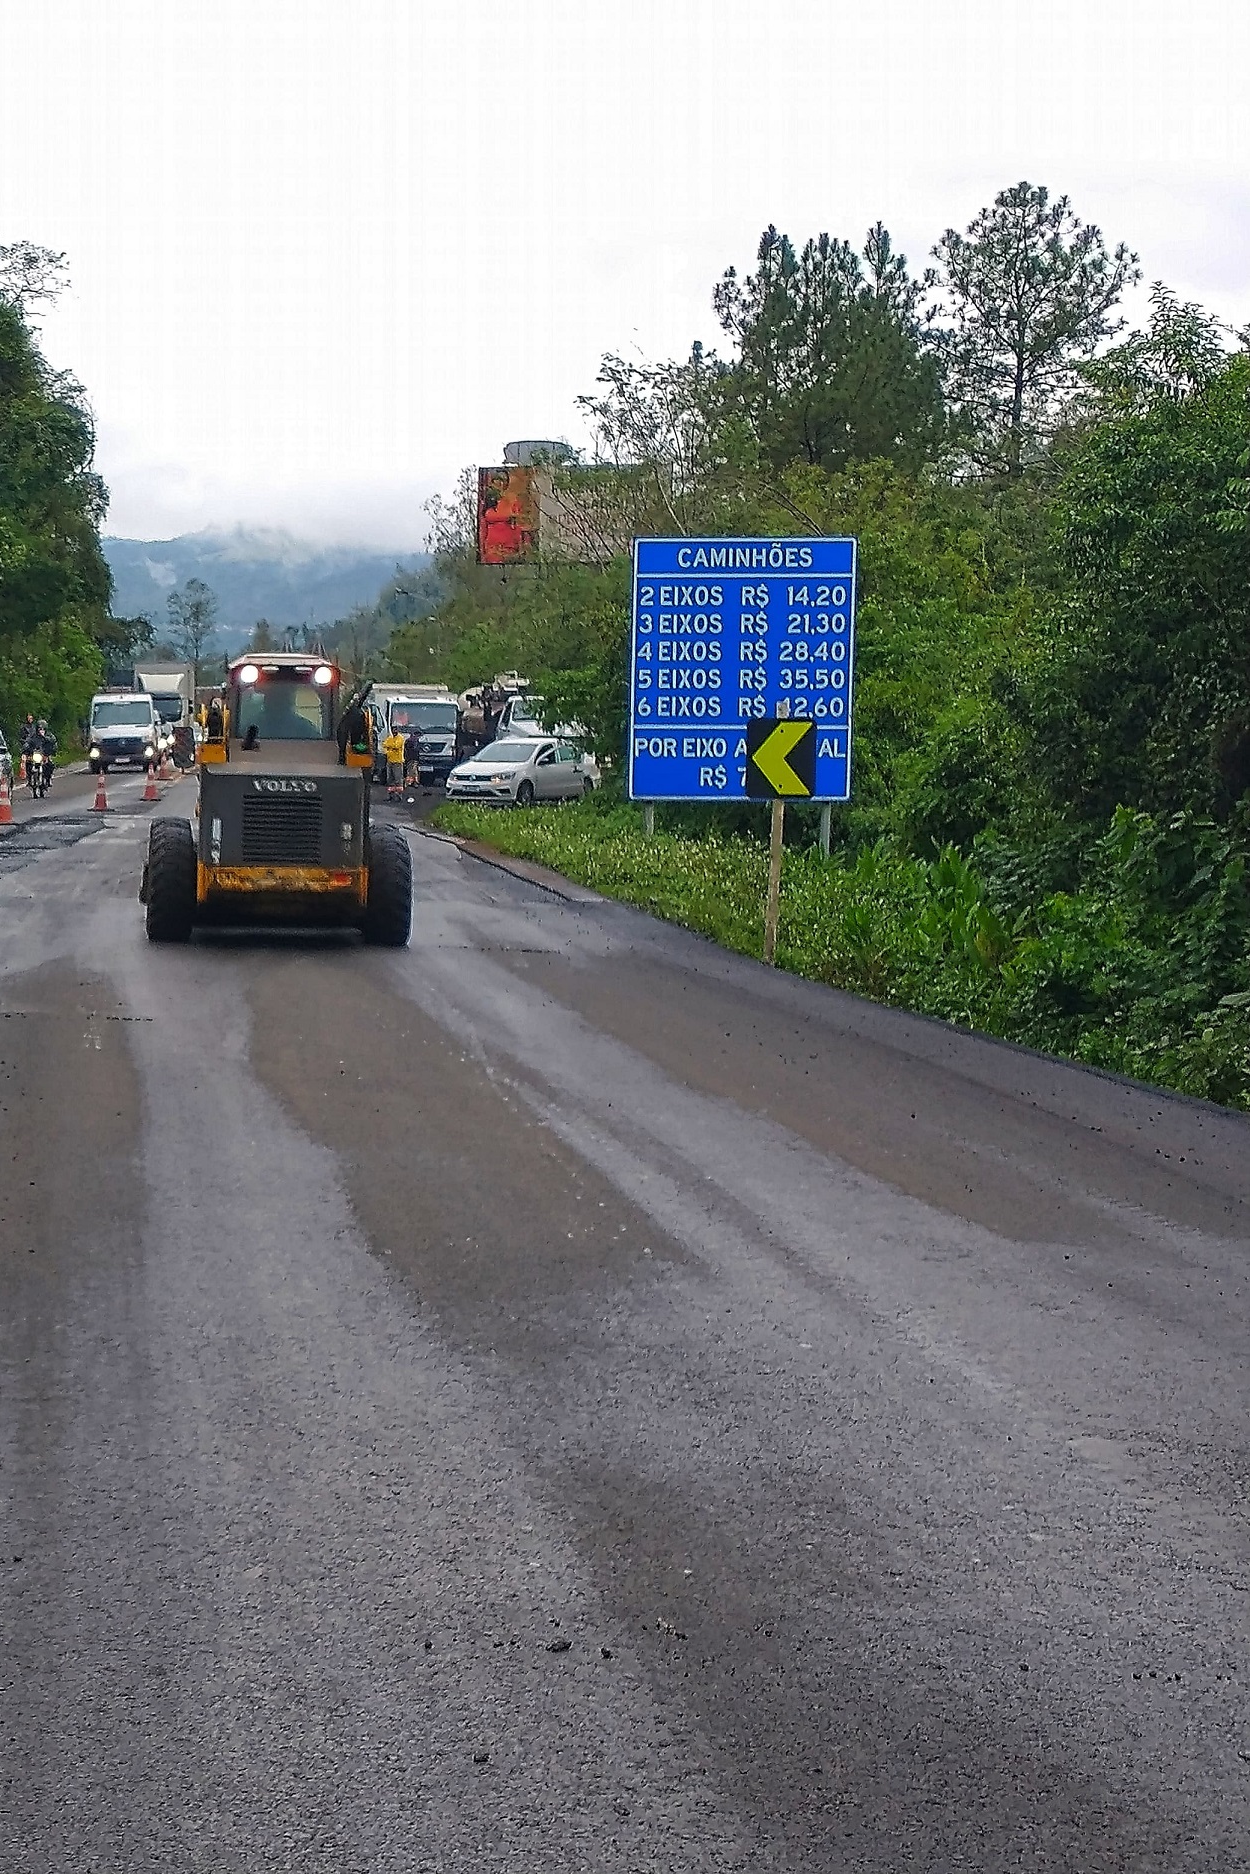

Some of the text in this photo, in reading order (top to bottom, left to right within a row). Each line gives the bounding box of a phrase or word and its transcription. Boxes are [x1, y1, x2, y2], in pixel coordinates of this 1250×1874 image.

[678, 543, 813, 568] CAMINHÕES
[641, 584, 846, 609] 2 EIXOS R$ 14,20
[640, 612, 845, 636] 3 EIXOS R$ 21,30
[638, 640, 845, 664] 4 EIXOS R$ 28,40
[638, 668, 845, 692] 5 EIXOS R$ 35,50
[638, 697, 651, 716] 6
[658, 697, 721, 717] EIXOS
[739, 696, 766, 718] R$
[635, 738, 676, 757] POR
[683, 738, 727, 757] EIXO
[252, 779, 318, 792] VOLVO
[700, 765, 727, 789] R$
